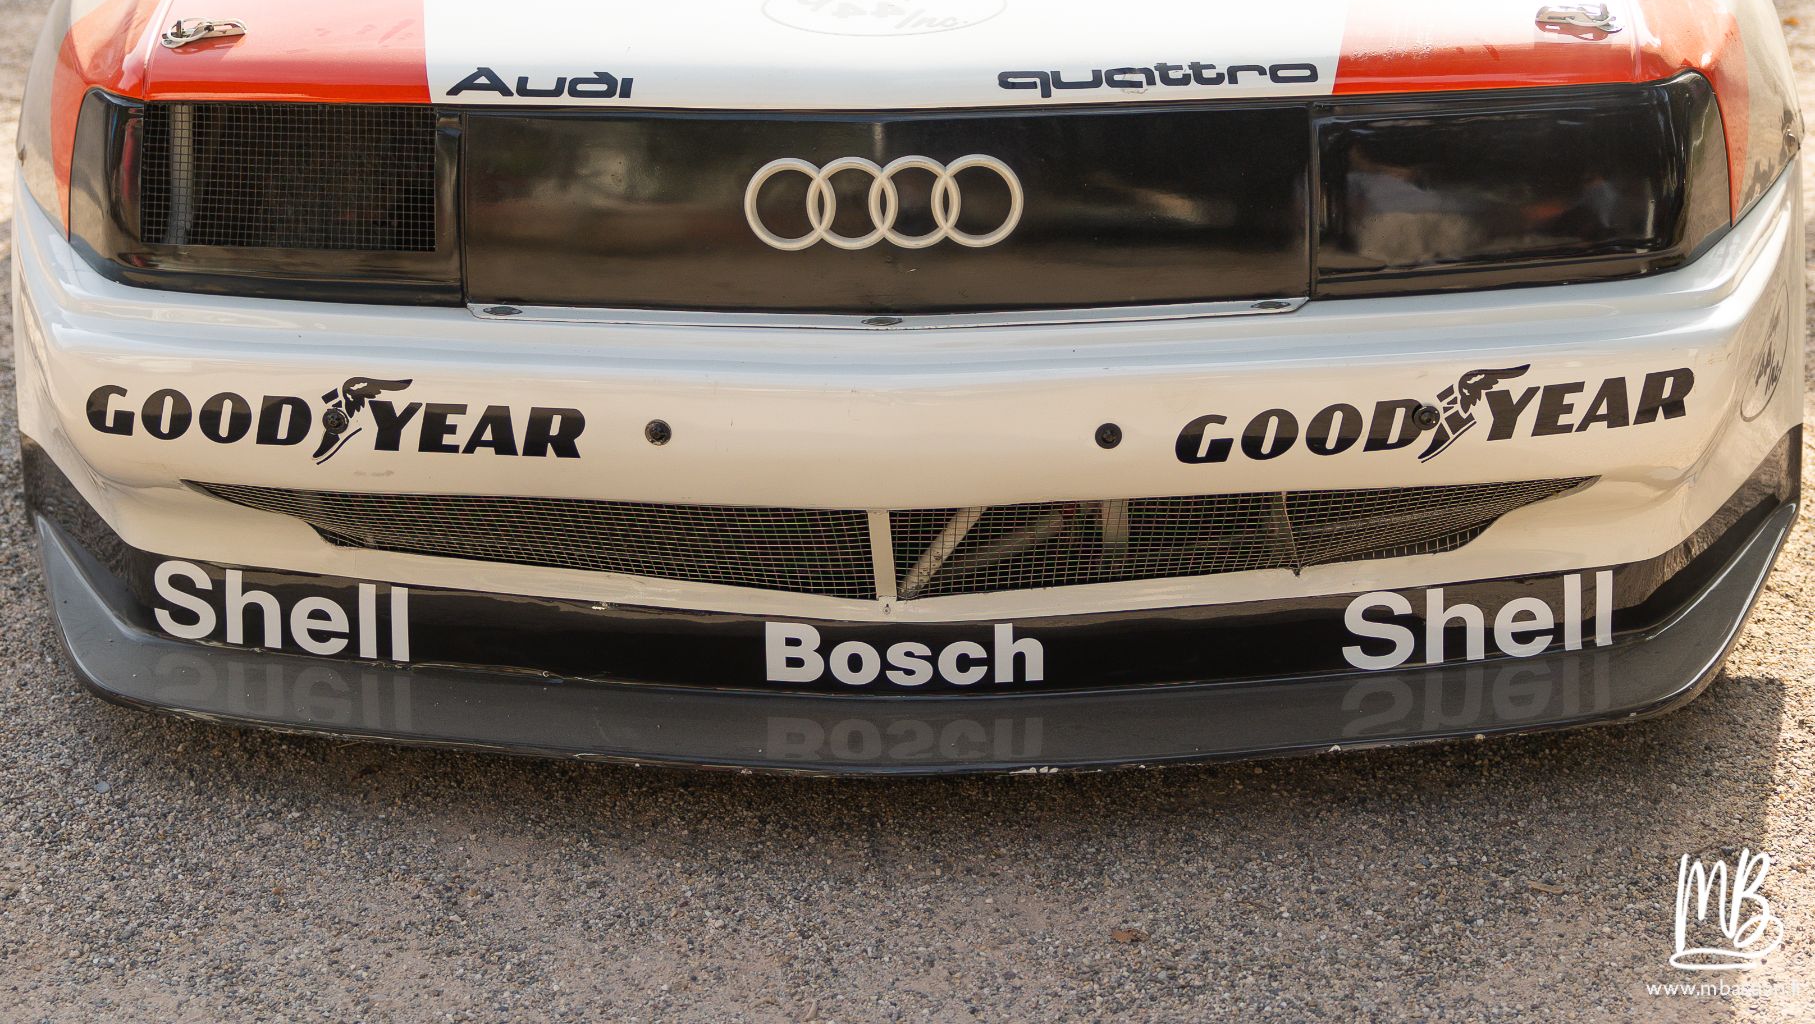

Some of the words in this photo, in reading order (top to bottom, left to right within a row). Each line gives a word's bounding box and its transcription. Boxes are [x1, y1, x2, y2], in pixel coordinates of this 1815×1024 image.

[446, 67, 634, 99] Audi
[997, 62, 1319, 99] quattro
[153, 560, 410, 662] Shell
[1342, 570, 1614, 671] Shell
[765, 622, 1045, 686] Bosch
